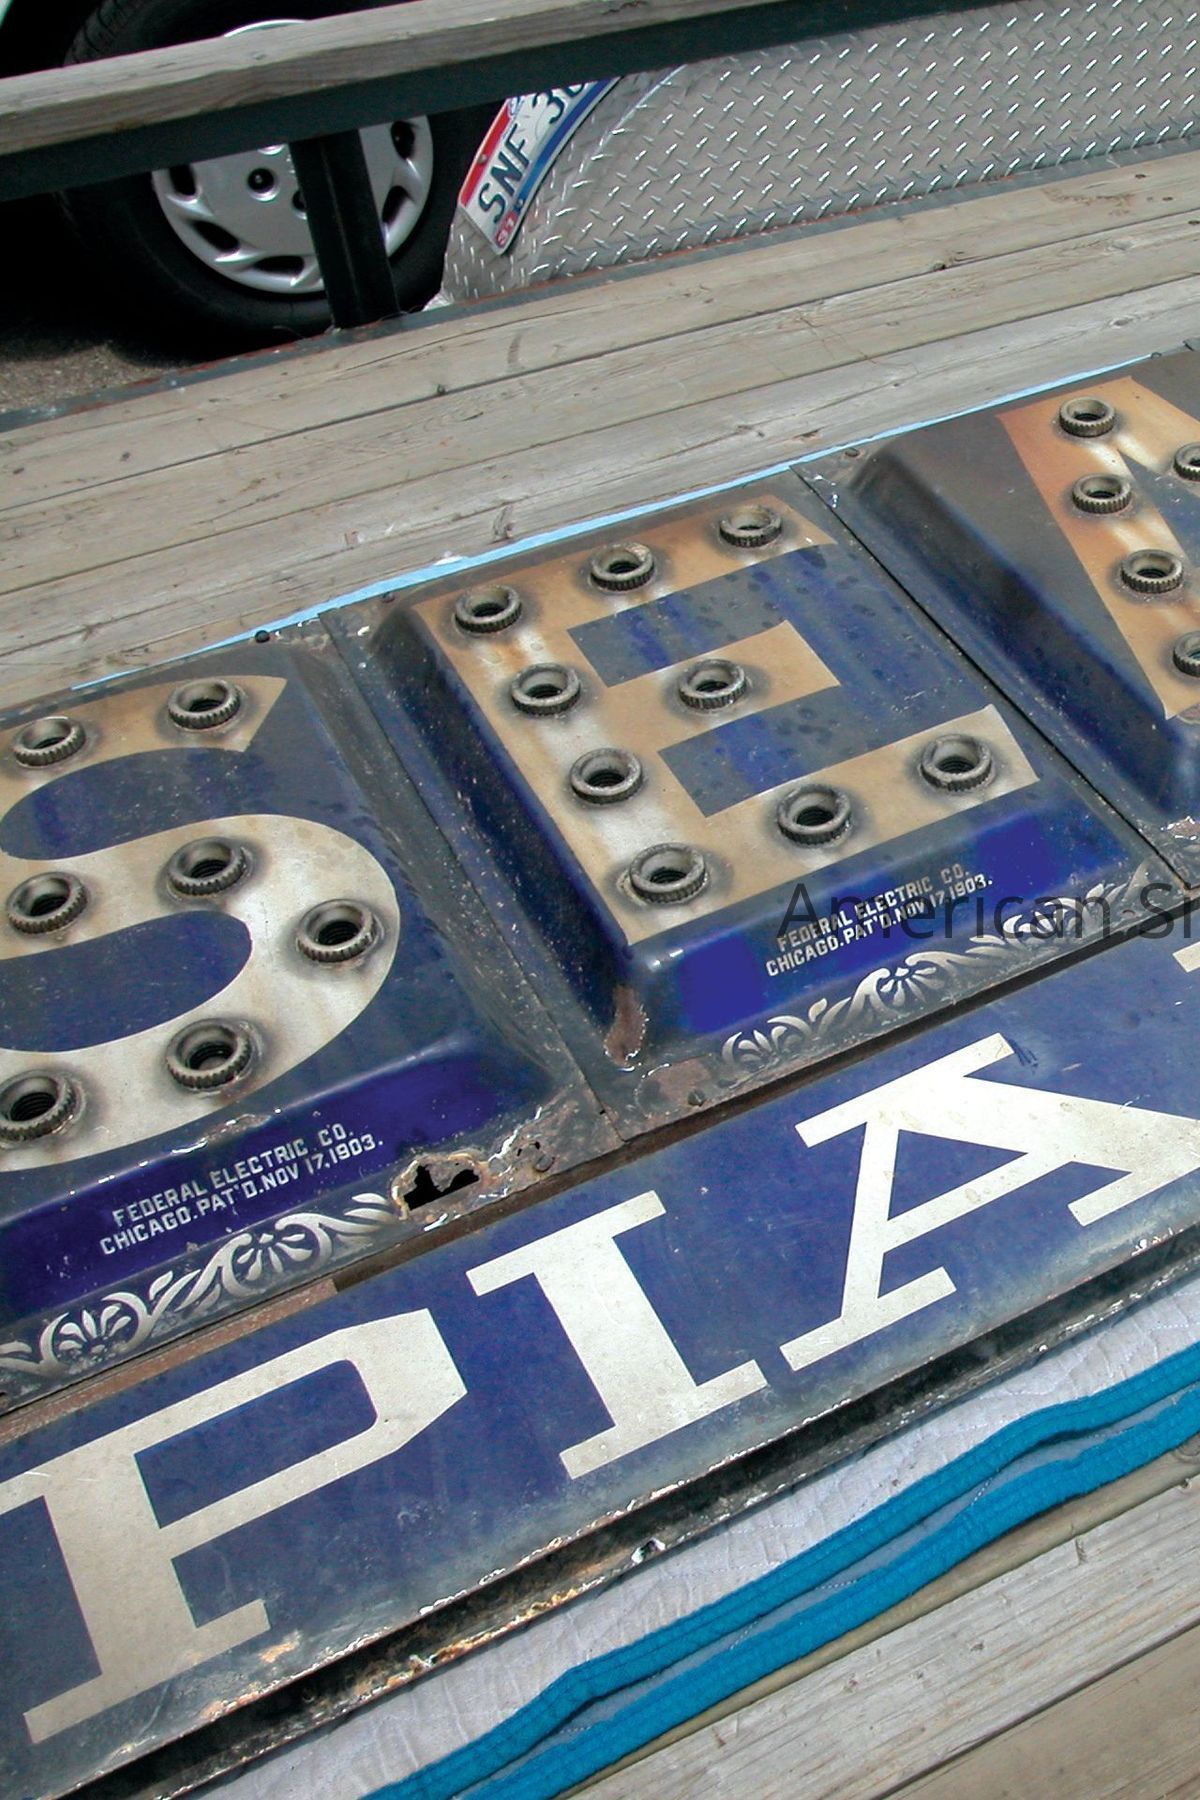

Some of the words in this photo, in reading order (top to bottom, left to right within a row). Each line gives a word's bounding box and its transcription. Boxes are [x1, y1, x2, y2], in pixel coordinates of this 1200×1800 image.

[478, 123, 530, 224] SNF
[532, 83, 587, 124] 3
[777, 910, 854, 952] FEDERAL
[855, 875, 934, 919] ELECTRIC
[940, 863, 970, 885] CO.
[111, 1183, 208, 1228] FEDERAL
[209, 1138, 309, 1190] ELECTRIC
[318, 1122, 356, 1149] CO.
